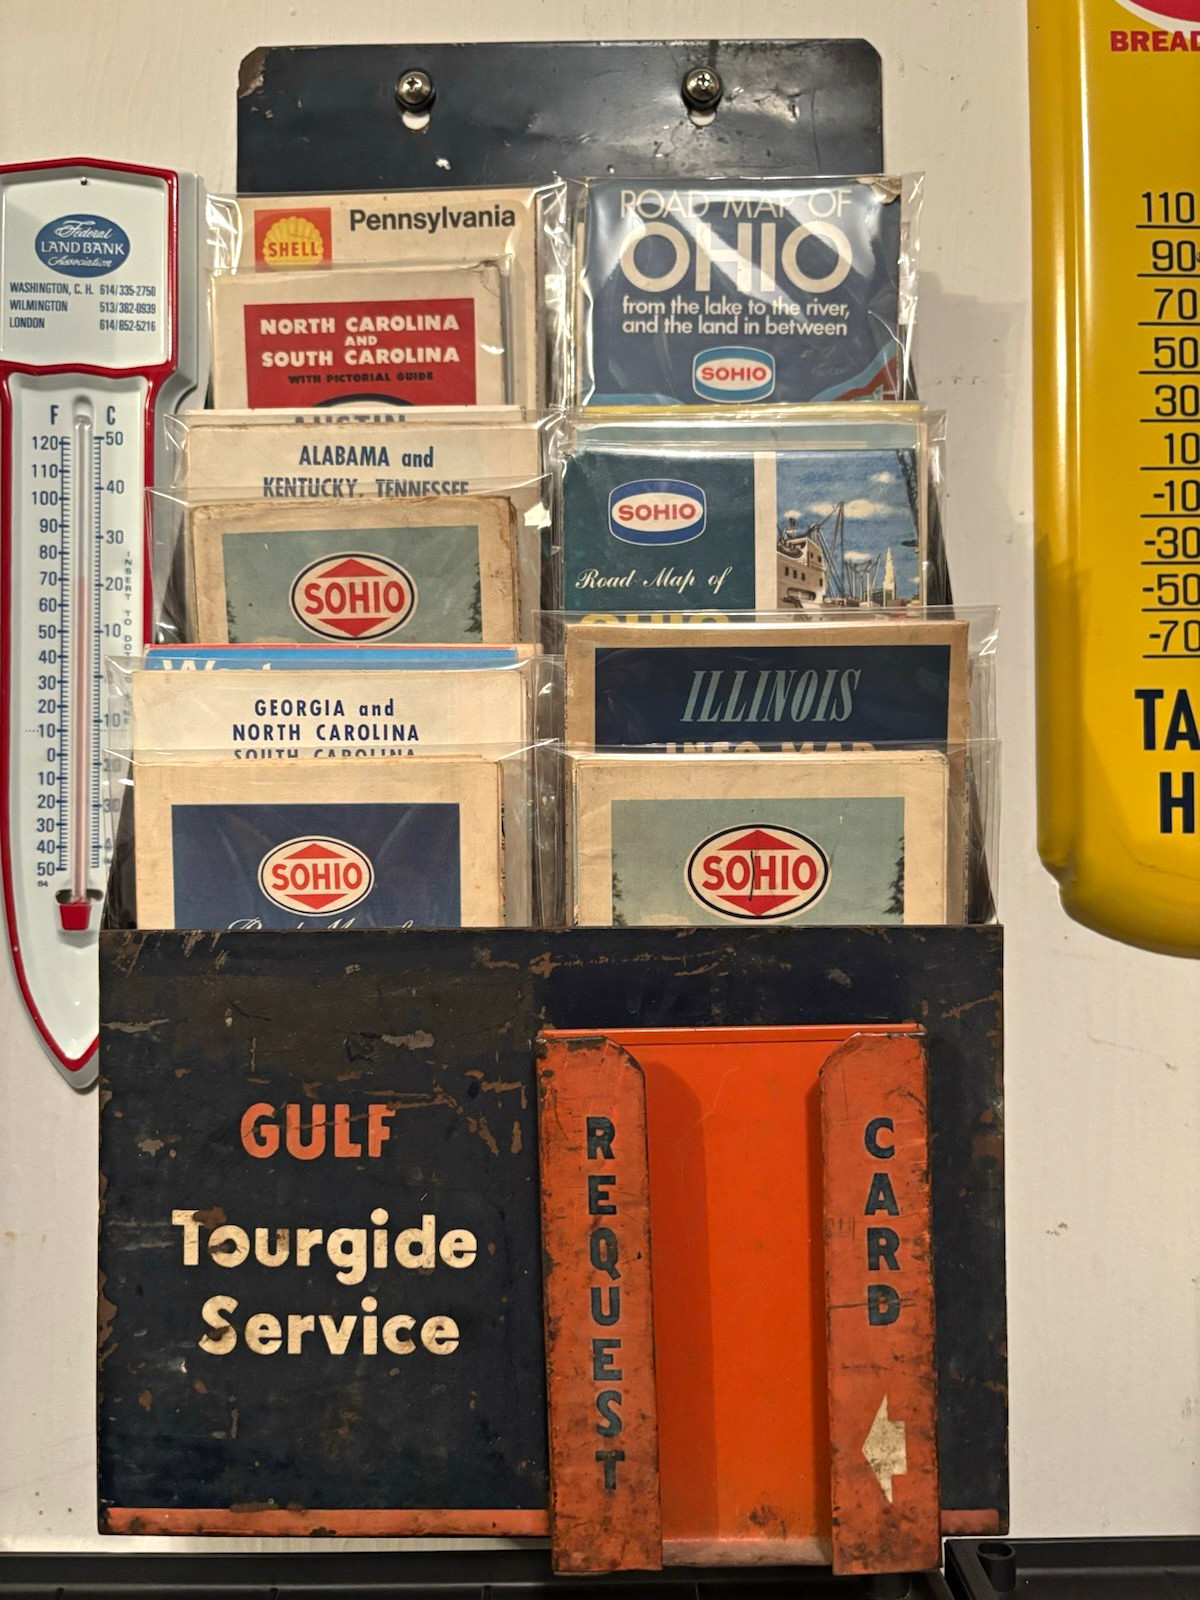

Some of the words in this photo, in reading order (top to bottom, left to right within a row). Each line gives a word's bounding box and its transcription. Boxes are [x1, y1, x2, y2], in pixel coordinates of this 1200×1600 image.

[620, 189, 709, 218] ROAD
[723, 190, 793, 218] MAP
[808, 190, 852, 218] OF
[1141, 192, 1195, 223] 110
[350, 205, 515, 234] Pennsylvania
[55, 220, 113, 239] Federal
[41, 241, 80, 253] LAND
[83, 243, 125, 255] BANK
[268, 241, 319, 257] SHELL
[620, 221, 852, 293] OHIO
[1152, 240, 1196, 272] 90
[48, 255, 112, 267] Association
[10, 282, 71, 295] WASHINGTON,
[74, 285, 82, 294] C.
[85, 285, 94, 295] H.
[10, 300, 68, 312] WILMINGTON
[622, 296, 665, 315] from
[671, 297, 699, 315] the
[705, 297, 742, 316] lake
[748, 300, 766, 316] to
[770, 298, 800, 316] the
[806, 300, 850, 320] river,
[1153, 288, 1198, 320] 70
[10, 317, 45, 329] LONDON
[260, 317, 335, 335] NORTH
[345, 314, 460, 333] CAROLINA
[622, 316, 658, 334] and
[664, 316, 692, 334] the
[698, 316, 738, 335] land
[744, 317, 760, 335] in
[765, 317, 847, 336] between
[344, 335, 378, 346] AND
[261, 351, 333, 367] SOUTH
[344, 346, 460, 365] CAROLINA
[1153, 337, 1199, 369] 50
[288, 374, 321, 384] WITH
[326, 373, 391, 383] PICTORIAL
[397, 371, 433, 381] GUIDE
[701, 366, 767, 381] SOHIO
[1155, 384, 1200, 417] 30
[50, 406, 59, 425] F
[107, 405, 116, 425] C
[32, 436, 58, 450] 120
[105, 431, 123, 446] 50
[299, 445, 390, 467] ALABAMA
[402, 446, 434, 468] and
[1164, 432, 1200, 464] 10
[32, 464, 58, 478] 110
[106, 480, 124, 494] 40
[263, 477, 365, 499] KENTUCKY,
[1153, 479, 1200, 512] -10
[32, 491, 58, 505] 100
[618, 503, 696, 521] SOHIO
[39, 519, 57, 533] 90
[106, 531, 123, 544] 30
[1144, 526, 1200, 559] -30
[39, 545, 57, 559] 80
[40, 572, 57, 586] 70
[105, 577, 123, 591] 20
[575, 569, 636, 589] Road
[643, 566, 696, 594] Map
[707, 566, 733, 594] of
[304, 580, 405, 615] SOHIO
[1142, 573, 1200, 606] -50
[39, 598, 57, 612] 60
[38, 625, 57, 639] 50
[105, 624, 121, 638] 10
[1149, 620, 1200, 652] -70
[38, 650, 56, 664] 40
[38, 676, 56, 690] 30
[680, 669, 861, 723] ILLINOIS
[38, 699, 56, 714] 20
[254, 699, 345, 717] GEORGIA
[359, 698, 394, 717] and
[104, 713, 120, 727] 10
[1134, 689, 1200, 751] TA
[39, 724, 56, 738] 10
[233, 724, 300, 741] NORTH
[316, 724, 419, 742] CAROLINA
[47, 748, 56, 762] 0
[39, 772, 55, 786] 10
[38, 795, 55, 809] 20
[37, 818, 55, 832] 30
[37, 840, 55, 854] 40
[37, 862, 55, 876] 50
[271, 862, 363, 891] SOHIO
[702, 855, 817, 892] SOHIO
[240, 1102, 396, 1160] GULF
[864, 1117, 900, 1326] CARD
[172, 1208, 478, 1285] Tourgide
[586, 1116, 625, 1490] REQUEST
[198, 1295, 460, 1356] Service
